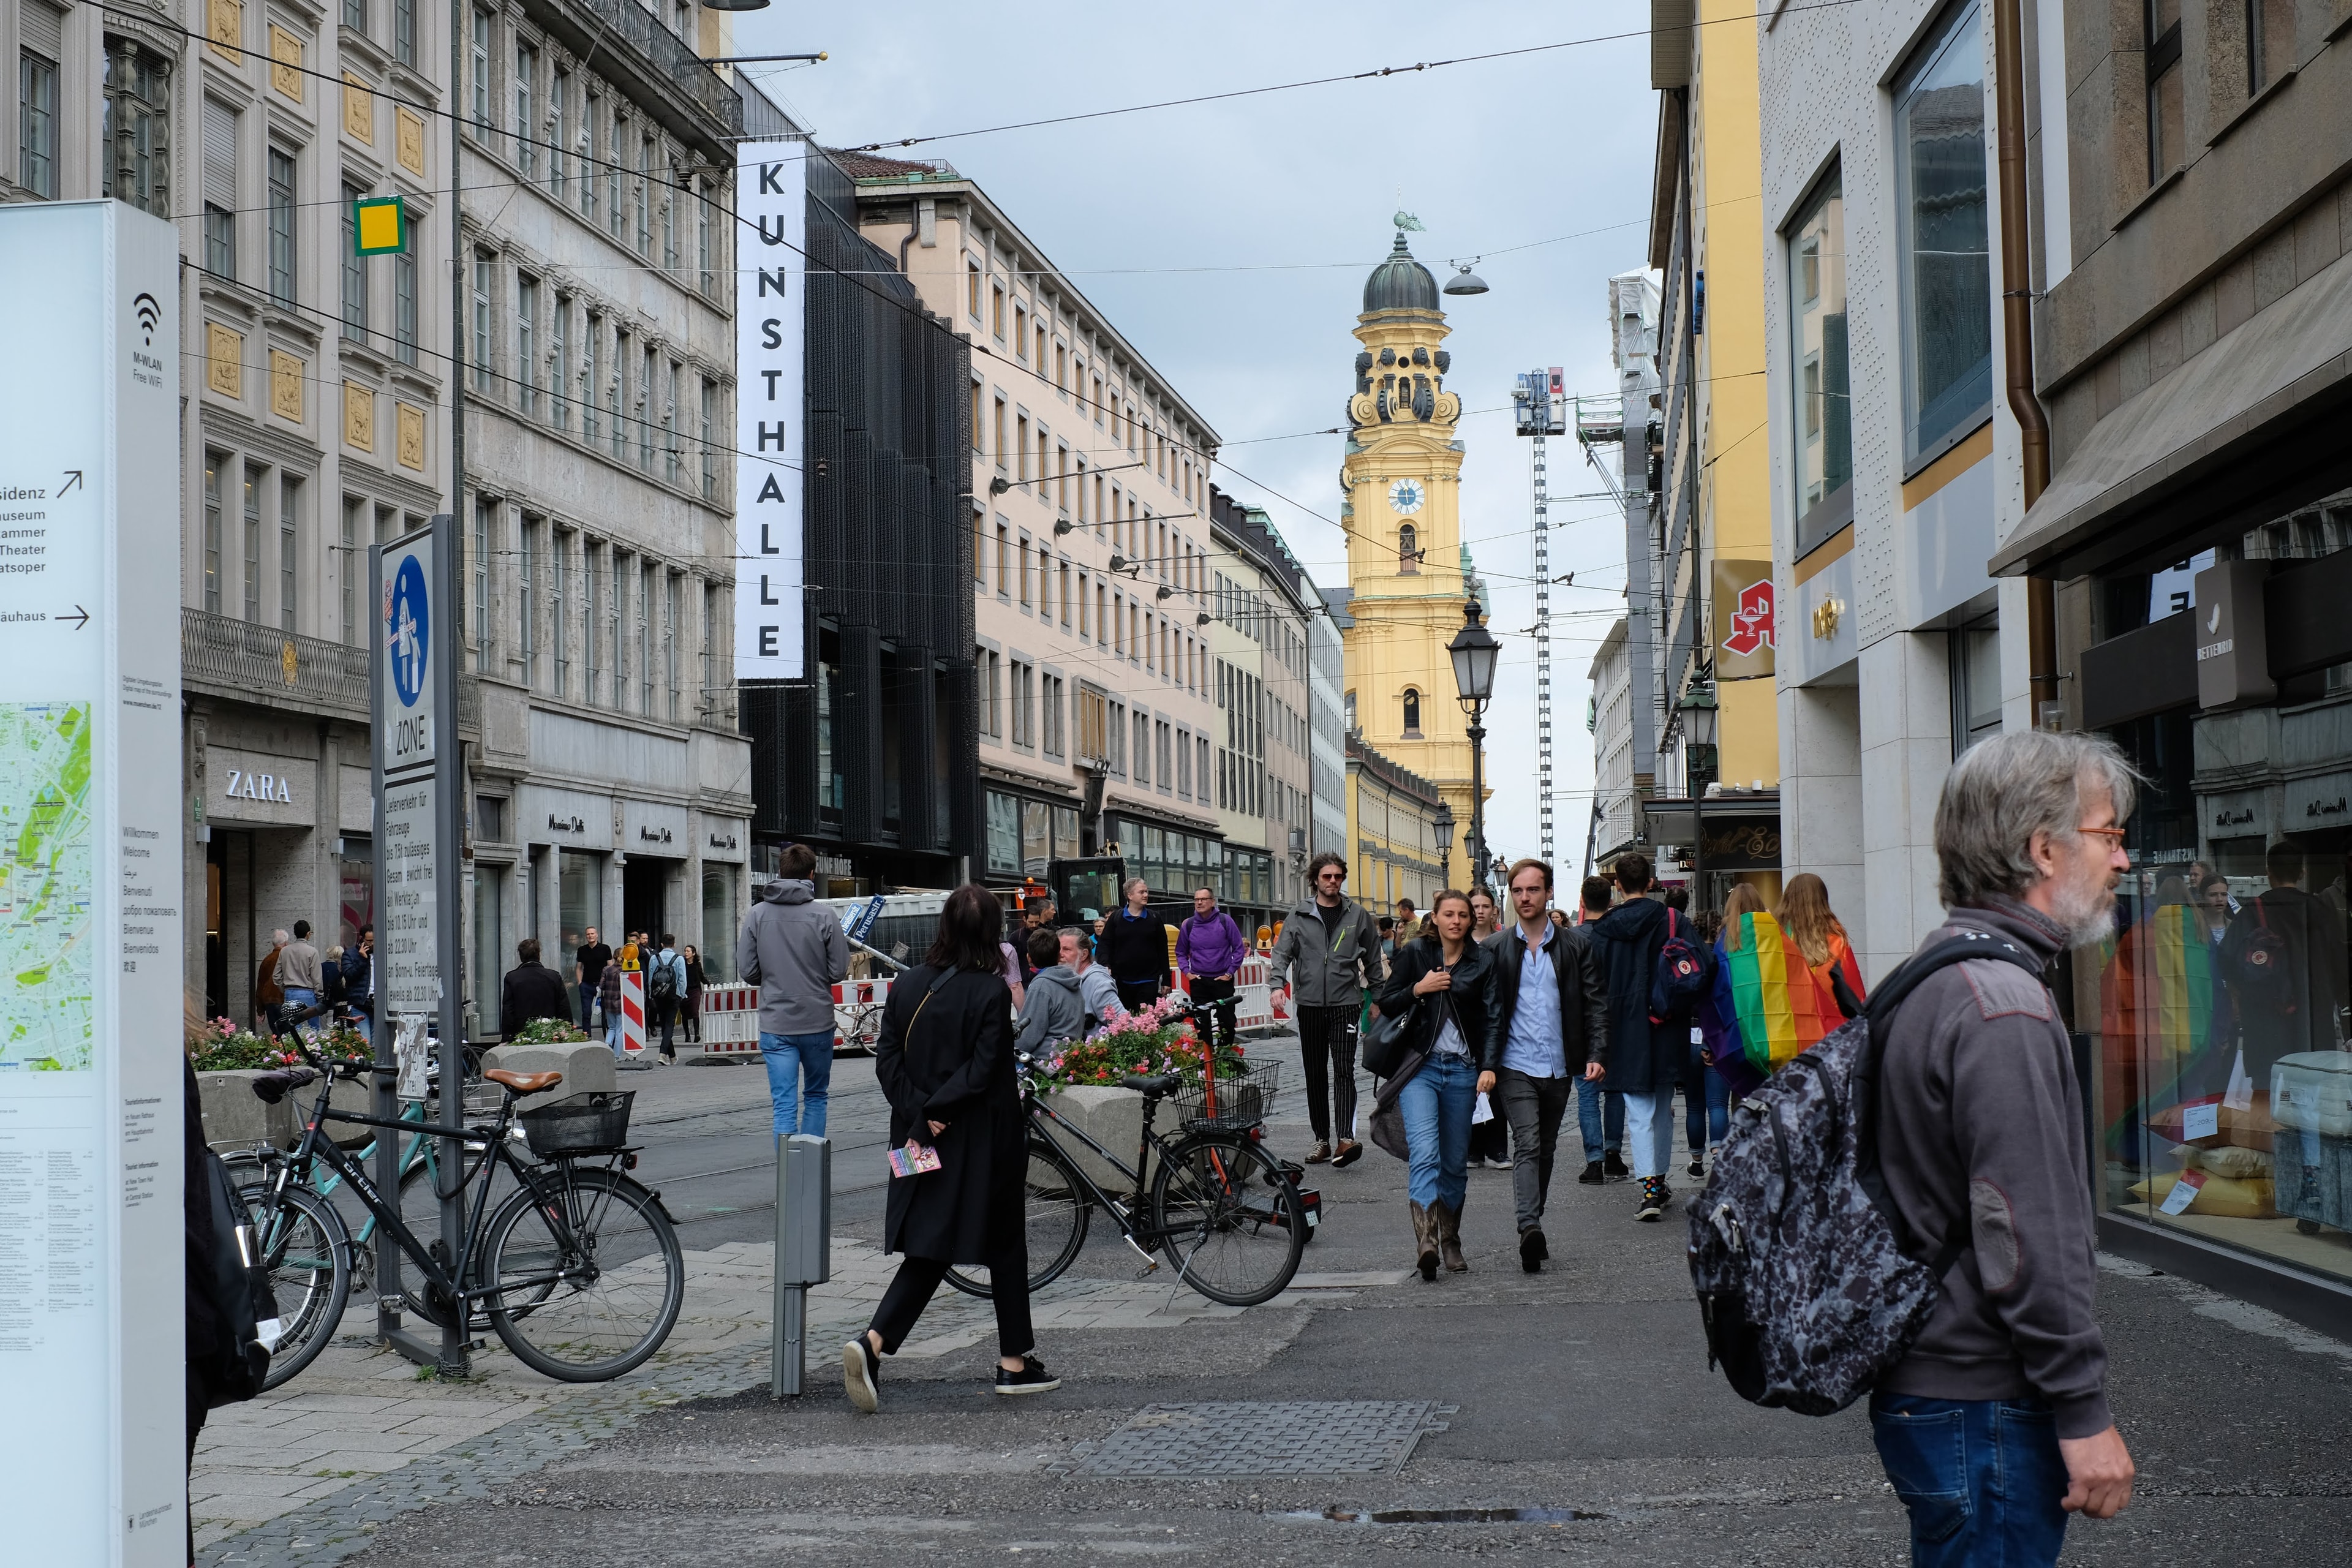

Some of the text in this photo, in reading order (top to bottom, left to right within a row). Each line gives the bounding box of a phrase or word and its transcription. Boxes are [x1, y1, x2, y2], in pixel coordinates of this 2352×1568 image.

[134, 351, 162, 372] M-WLAN
[133, 368, 162, 389] Free WiFi
[756, 162, 785, 657] KUNSTHALLE
[0, 529, 46, 538] ammer
[0, 545, 47, 556] Theater
[396, 714, 426, 756] ZONE
[225, 769, 292, 803] ZARA
[385, 791, 428, 814] Lieferverkehr für
[123, 826, 159, 839] Willkommen
[386, 821, 410, 839] Fahrzeuge
[123, 845, 151, 858] Welcome
[404, 840, 430, 860] zulässiges
[386, 862, 433, 884] Gesamewicht frei
[815, 851, 852, 876] FÜNF HÖFE
[123, 923, 154, 935] Bienvenue
[408, 913, 417, 930] Uhr
[418, 911, 428, 929] und
[855, 899, 883, 939] Perusastr.
[123, 942, 159, 954] Bienvenidos
[388, 937, 417, 955] ab 22.30 Uhr
[388, 966, 394, 978] an
[414, 961, 438, 981] Feiertage
[388, 984, 438, 1005] jeweils ab 22.30 Uhr
[407, 1079, 417, 1093] frei
[343, 1161, 383, 1205] ortler
